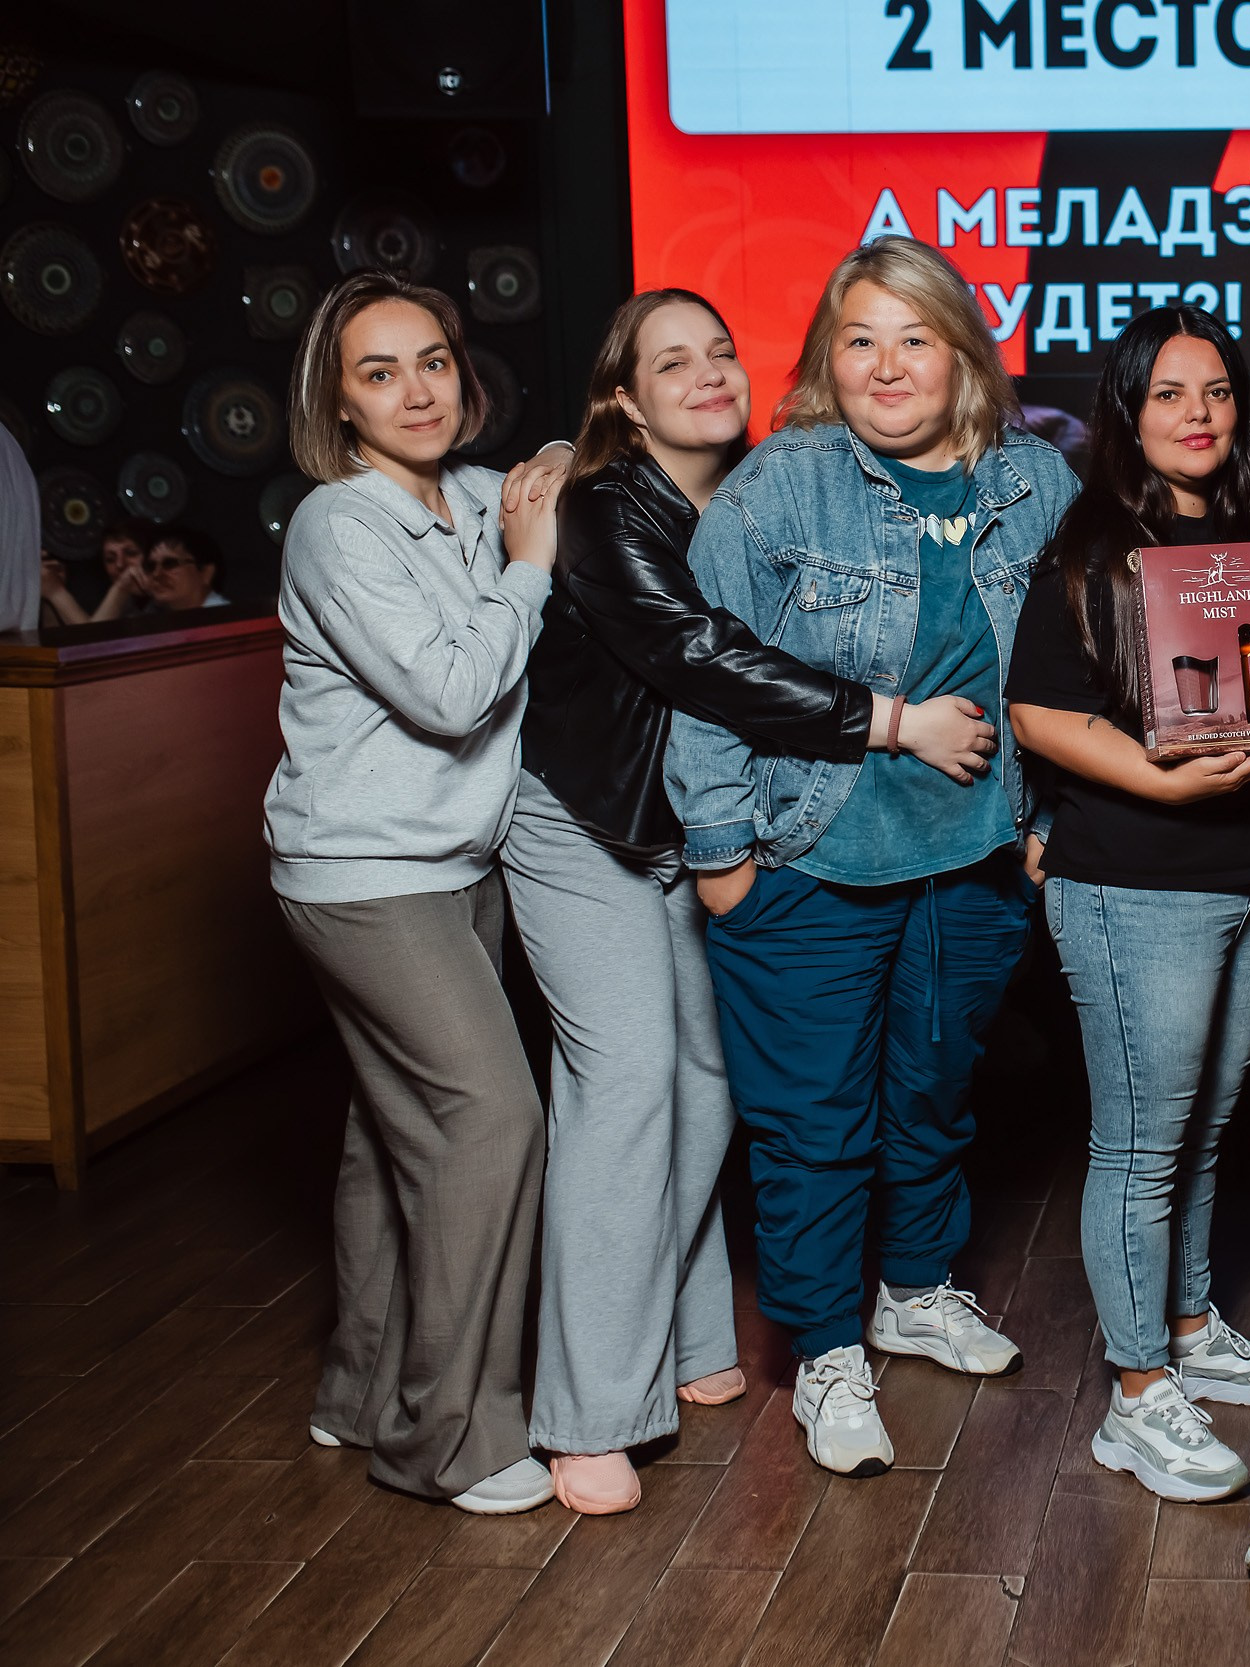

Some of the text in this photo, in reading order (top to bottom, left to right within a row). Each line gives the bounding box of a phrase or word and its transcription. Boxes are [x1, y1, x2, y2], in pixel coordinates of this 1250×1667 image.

[885, 0, 932, 70] 2
[860, 187, 915, 247] А
[967, 281, 1243, 353] УДЕТ?!
[1203, 606, 1237, 620] MIST
[1219, 730, 1246, 739] SCOTCH
